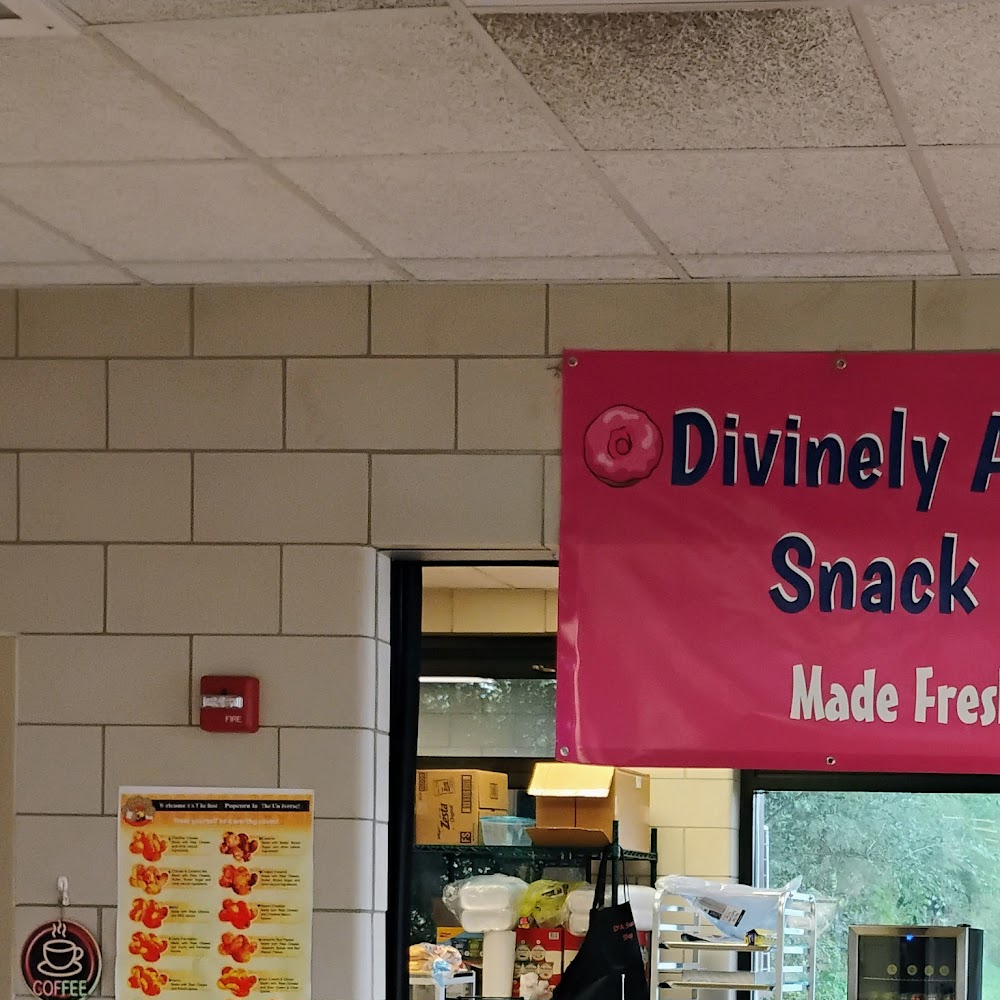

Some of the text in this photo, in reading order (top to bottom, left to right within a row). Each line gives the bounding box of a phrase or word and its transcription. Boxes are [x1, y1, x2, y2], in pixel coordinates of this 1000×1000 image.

[669, 407, 949, 512] Divinely
[768, 532, 979, 616] Snack
[790, 664, 898, 724] Made
[461, 832, 471, 843] FS
[33, 980, 87, 997] COFFEE
